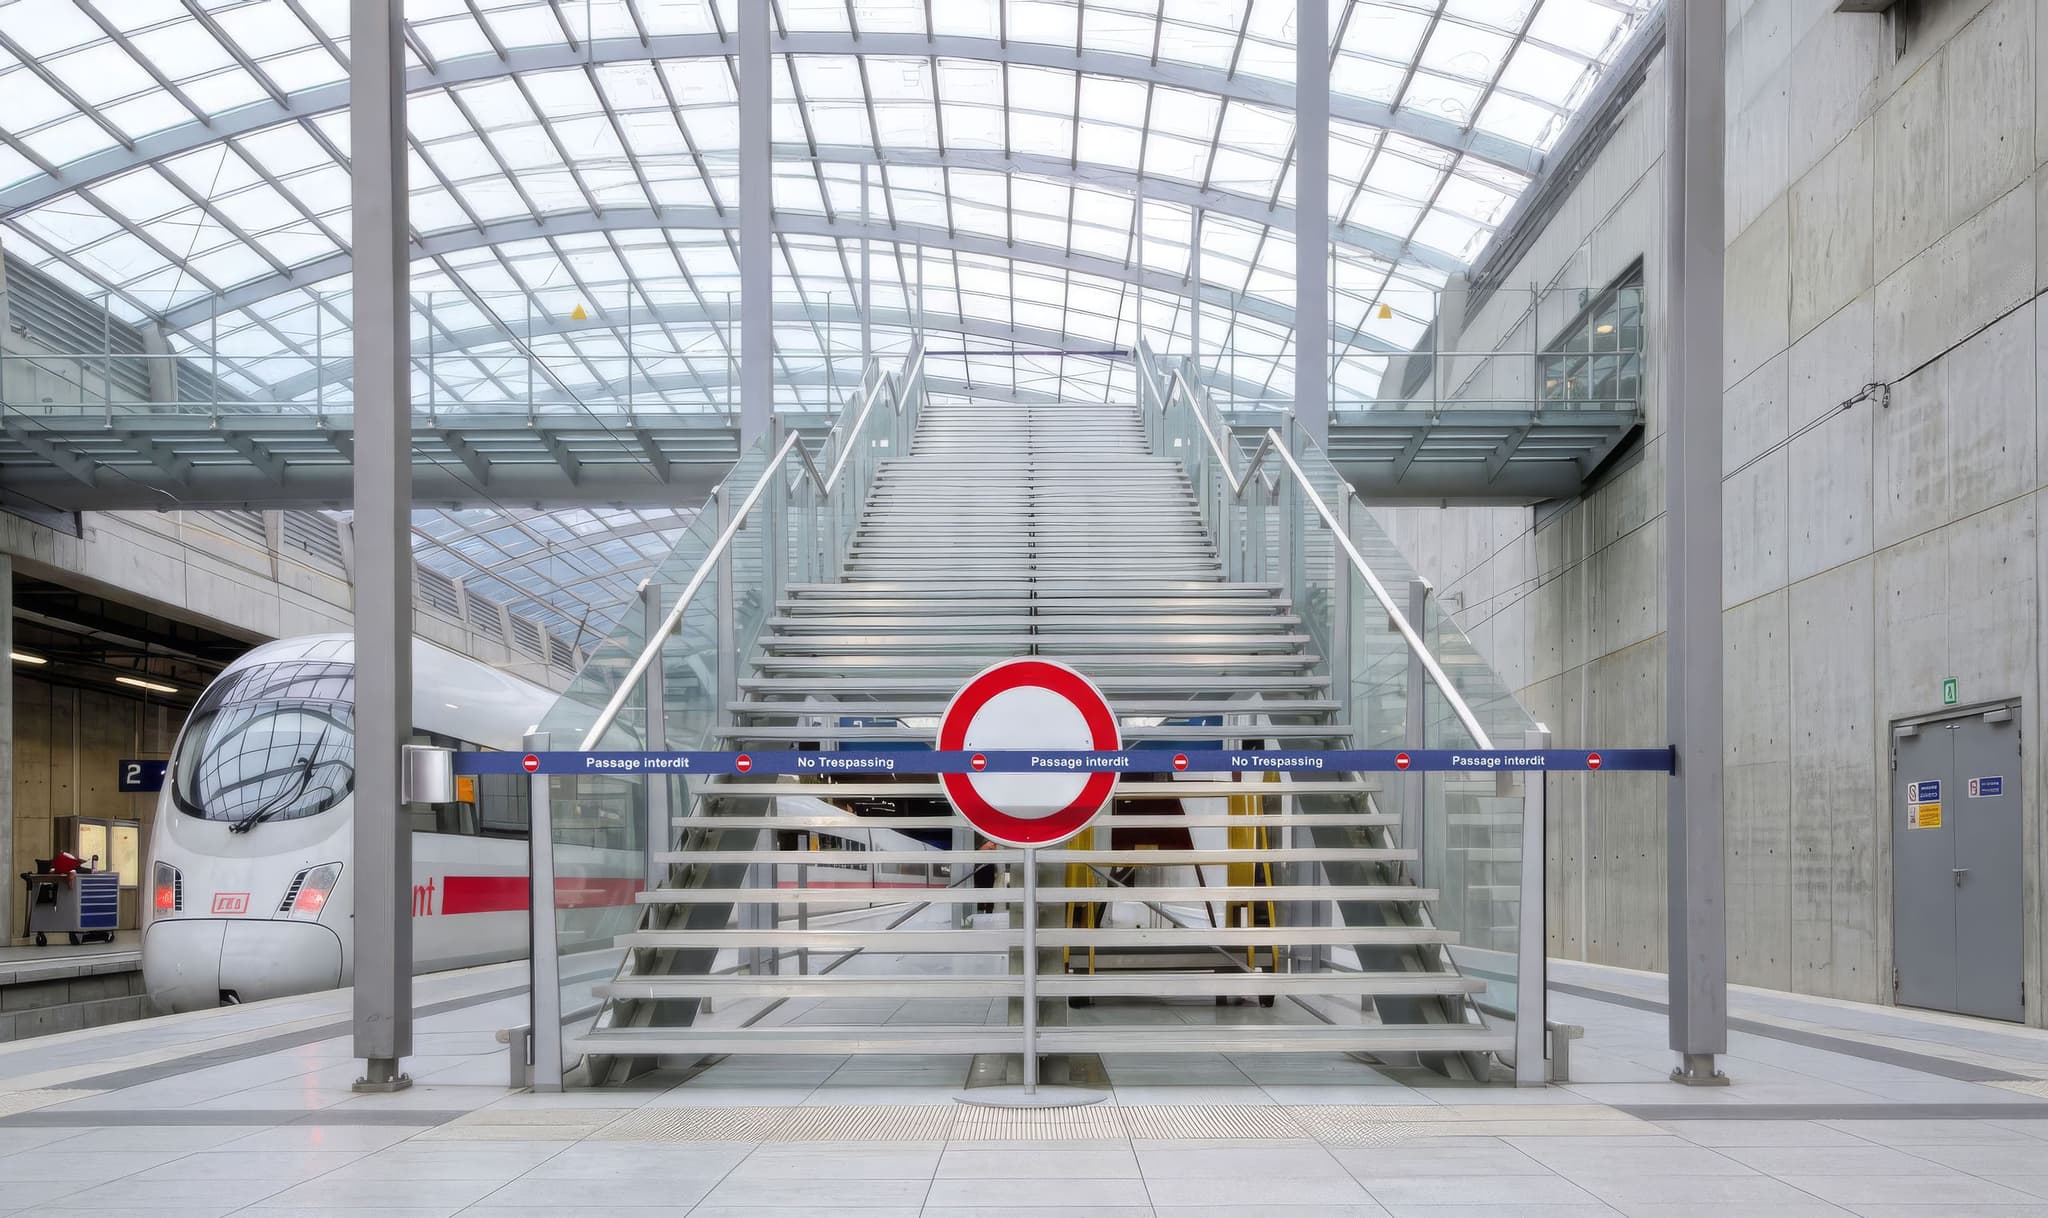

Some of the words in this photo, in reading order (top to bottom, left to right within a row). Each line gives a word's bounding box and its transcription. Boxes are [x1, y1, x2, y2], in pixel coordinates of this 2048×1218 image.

[586, 757, 641, 771] Passage
[644, 757, 690, 768] interdit
[797, 757, 816, 768] No
[818, 757, 895, 770] Trespassing
[1031, 757, 1083, 770] Passage
[1085, 756, 1129, 767] interdit
[1231, 756, 1249, 766] No
[1251, 756, 1323, 769] Trespassing
[1452, 756, 1501, 768] Passage
[1504, 756, 1545, 766] interdit
[126, 764, 141, 784] 2
